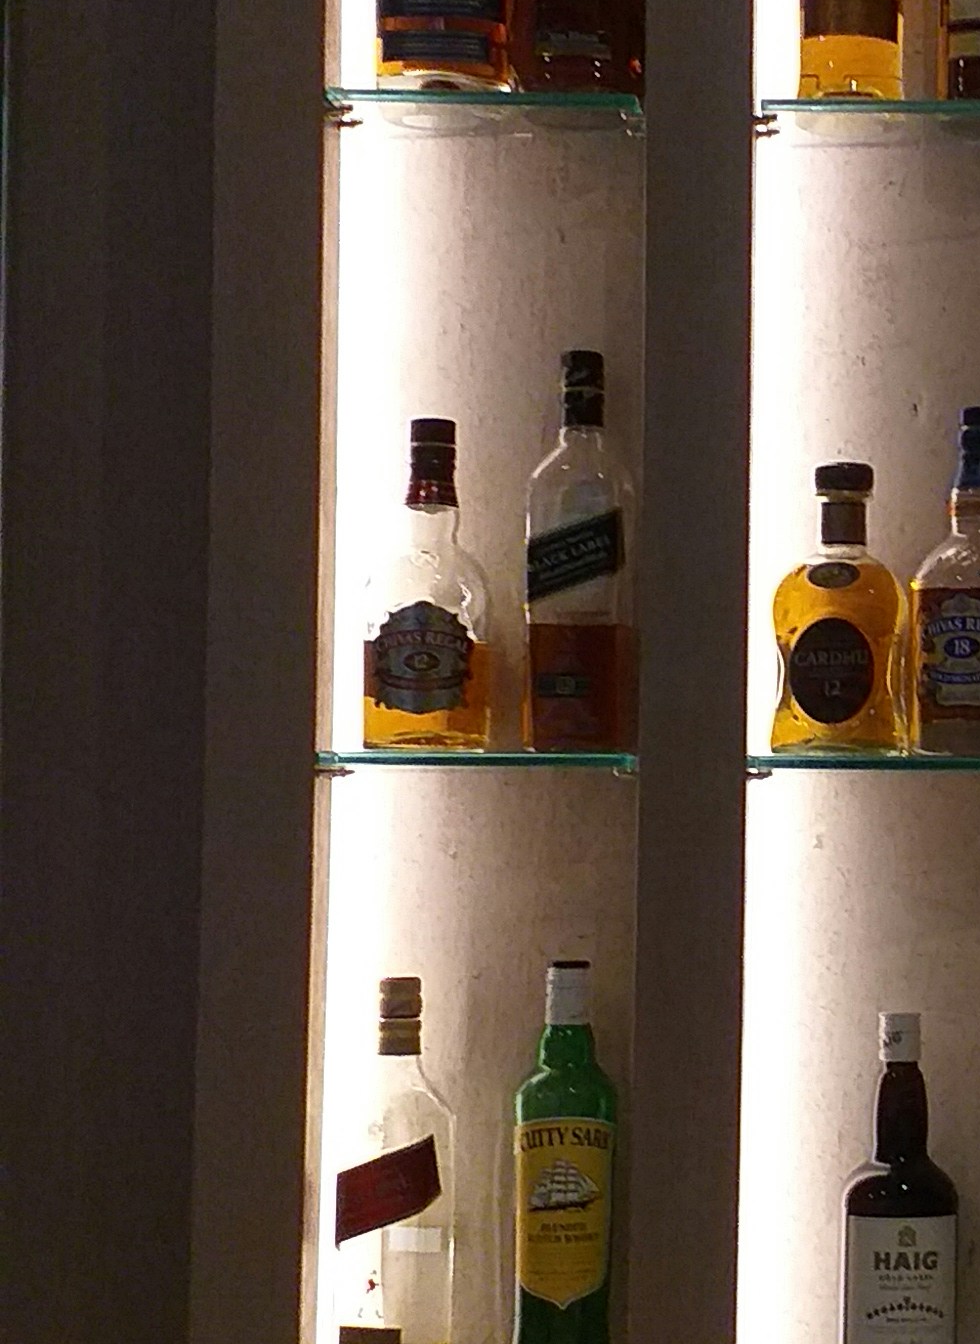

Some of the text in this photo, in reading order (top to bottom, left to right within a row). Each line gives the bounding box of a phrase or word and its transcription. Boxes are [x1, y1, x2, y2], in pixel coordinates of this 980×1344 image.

[376, 631, 469, 654] CHIVAS REGAL
[953, 638, 972, 656] 18
[794, 650, 868, 667] CARDHU
[824, 680, 842, 697] 12
[521, 1128, 568, 1154] CUTTY
[873, 1251, 939, 1271] HAIG
